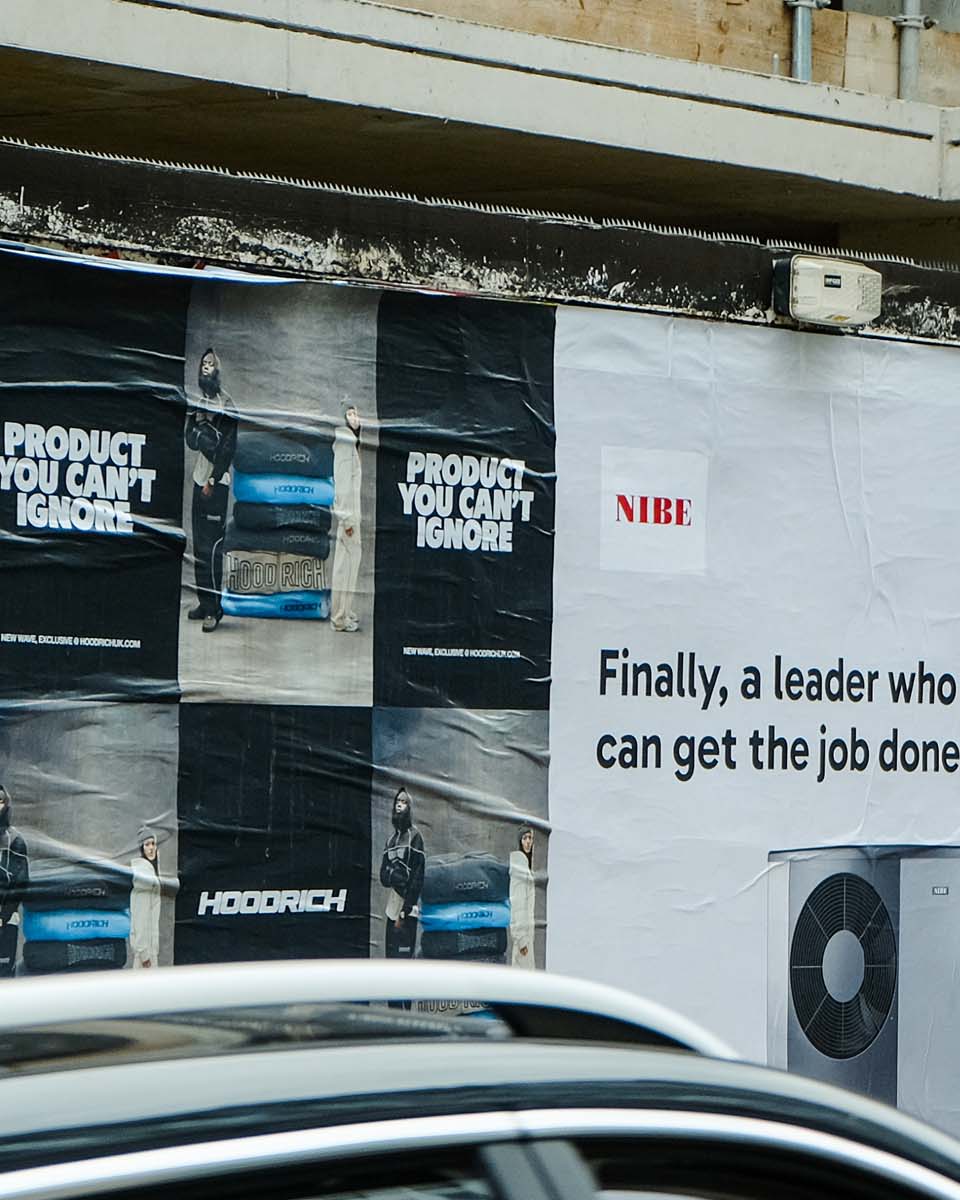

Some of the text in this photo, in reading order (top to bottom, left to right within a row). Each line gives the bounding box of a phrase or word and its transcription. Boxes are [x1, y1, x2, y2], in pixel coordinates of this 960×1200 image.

[4, 422, 146, 467] PRODUCT
[0, 456, 156, 502] YOU CAN'T
[406, 452, 525, 489] PRODUCT
[17, 493, 134, 533] IGNORE
[398, 483, 535, 522] YOU CAN'T
[615, 494, 692, 526] NIBE
[417, 516, 514, 552] IGNORE
[600, 648, 957, 710] Finally, a leader who
[596, 734, 662, 769] can
[673, 729, 737, 782] get
[749, 725, 809, 770] the
[817, 724, 870, 783] job
[198, 889, 348, 915] HOODRICH
